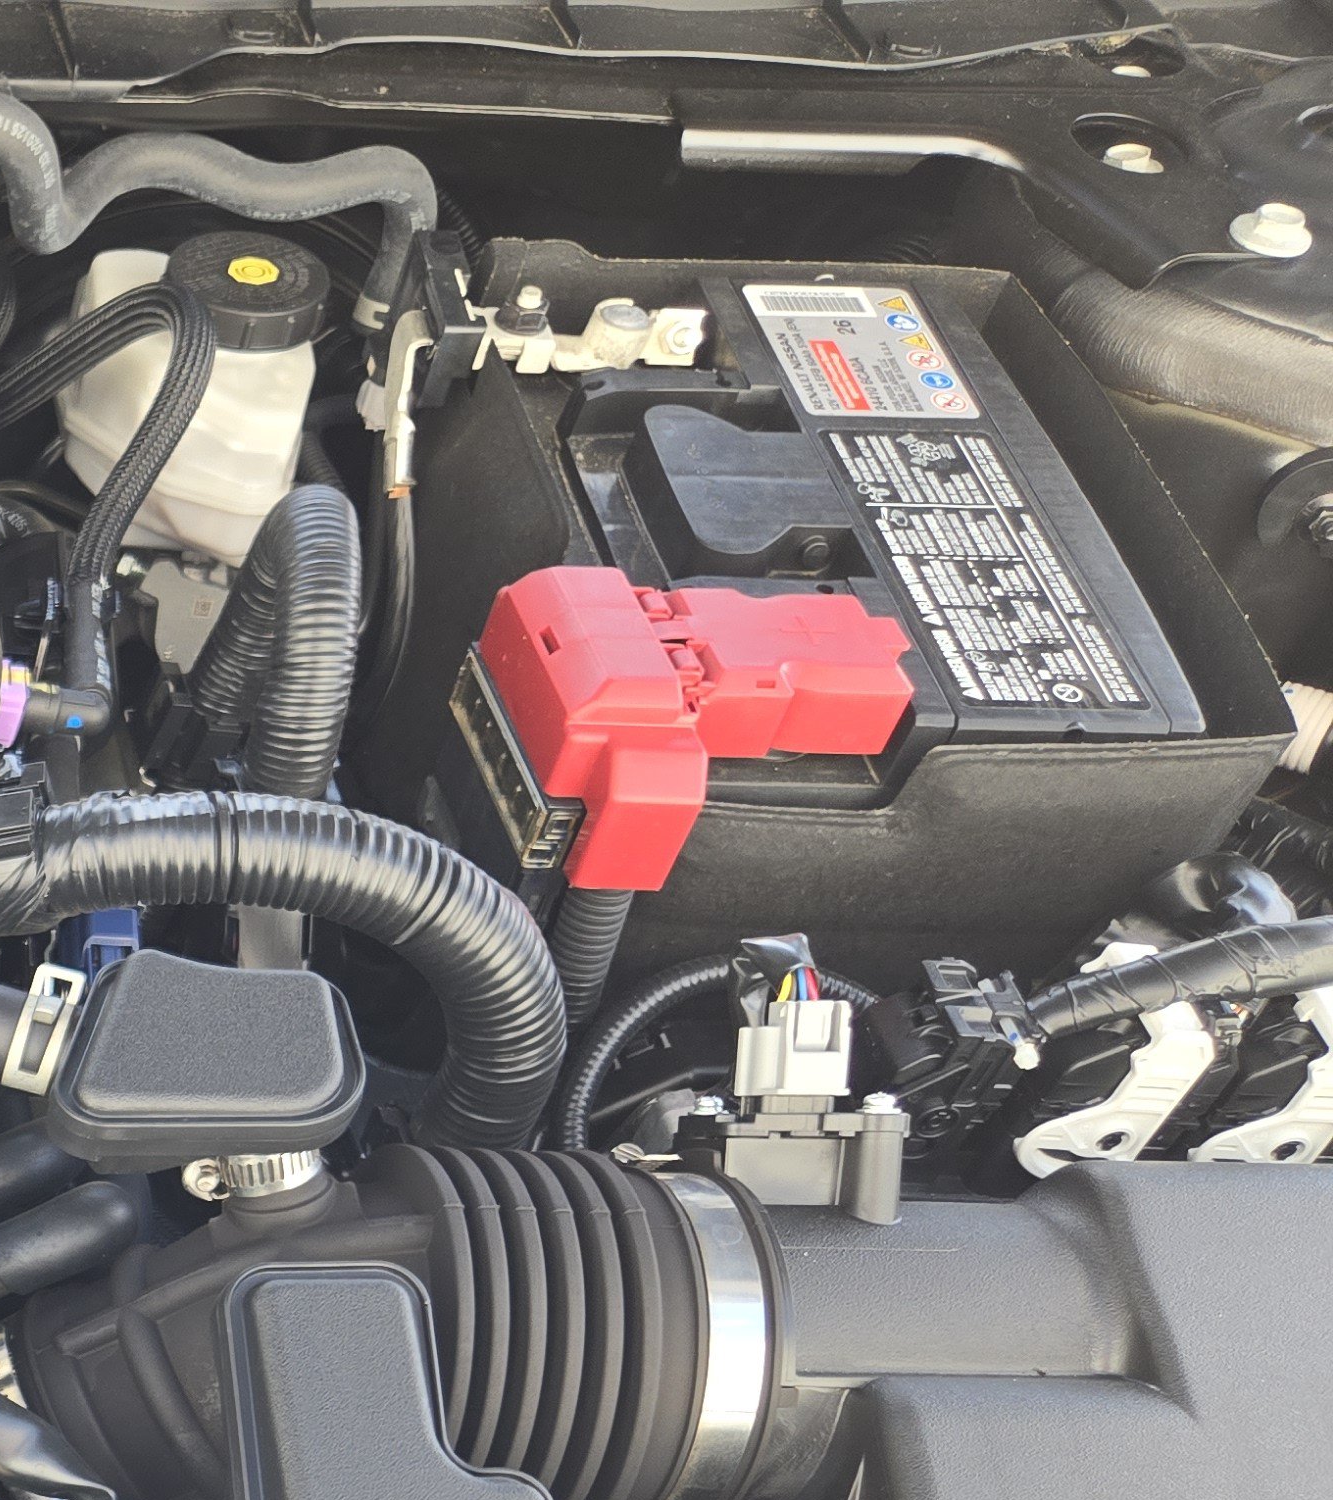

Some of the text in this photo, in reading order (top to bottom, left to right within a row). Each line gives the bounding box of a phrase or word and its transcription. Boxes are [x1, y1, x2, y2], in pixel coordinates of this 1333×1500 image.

[831, 319, 857, 335] 26
[773, 332, 826, 410] RENAULT NISSAN
